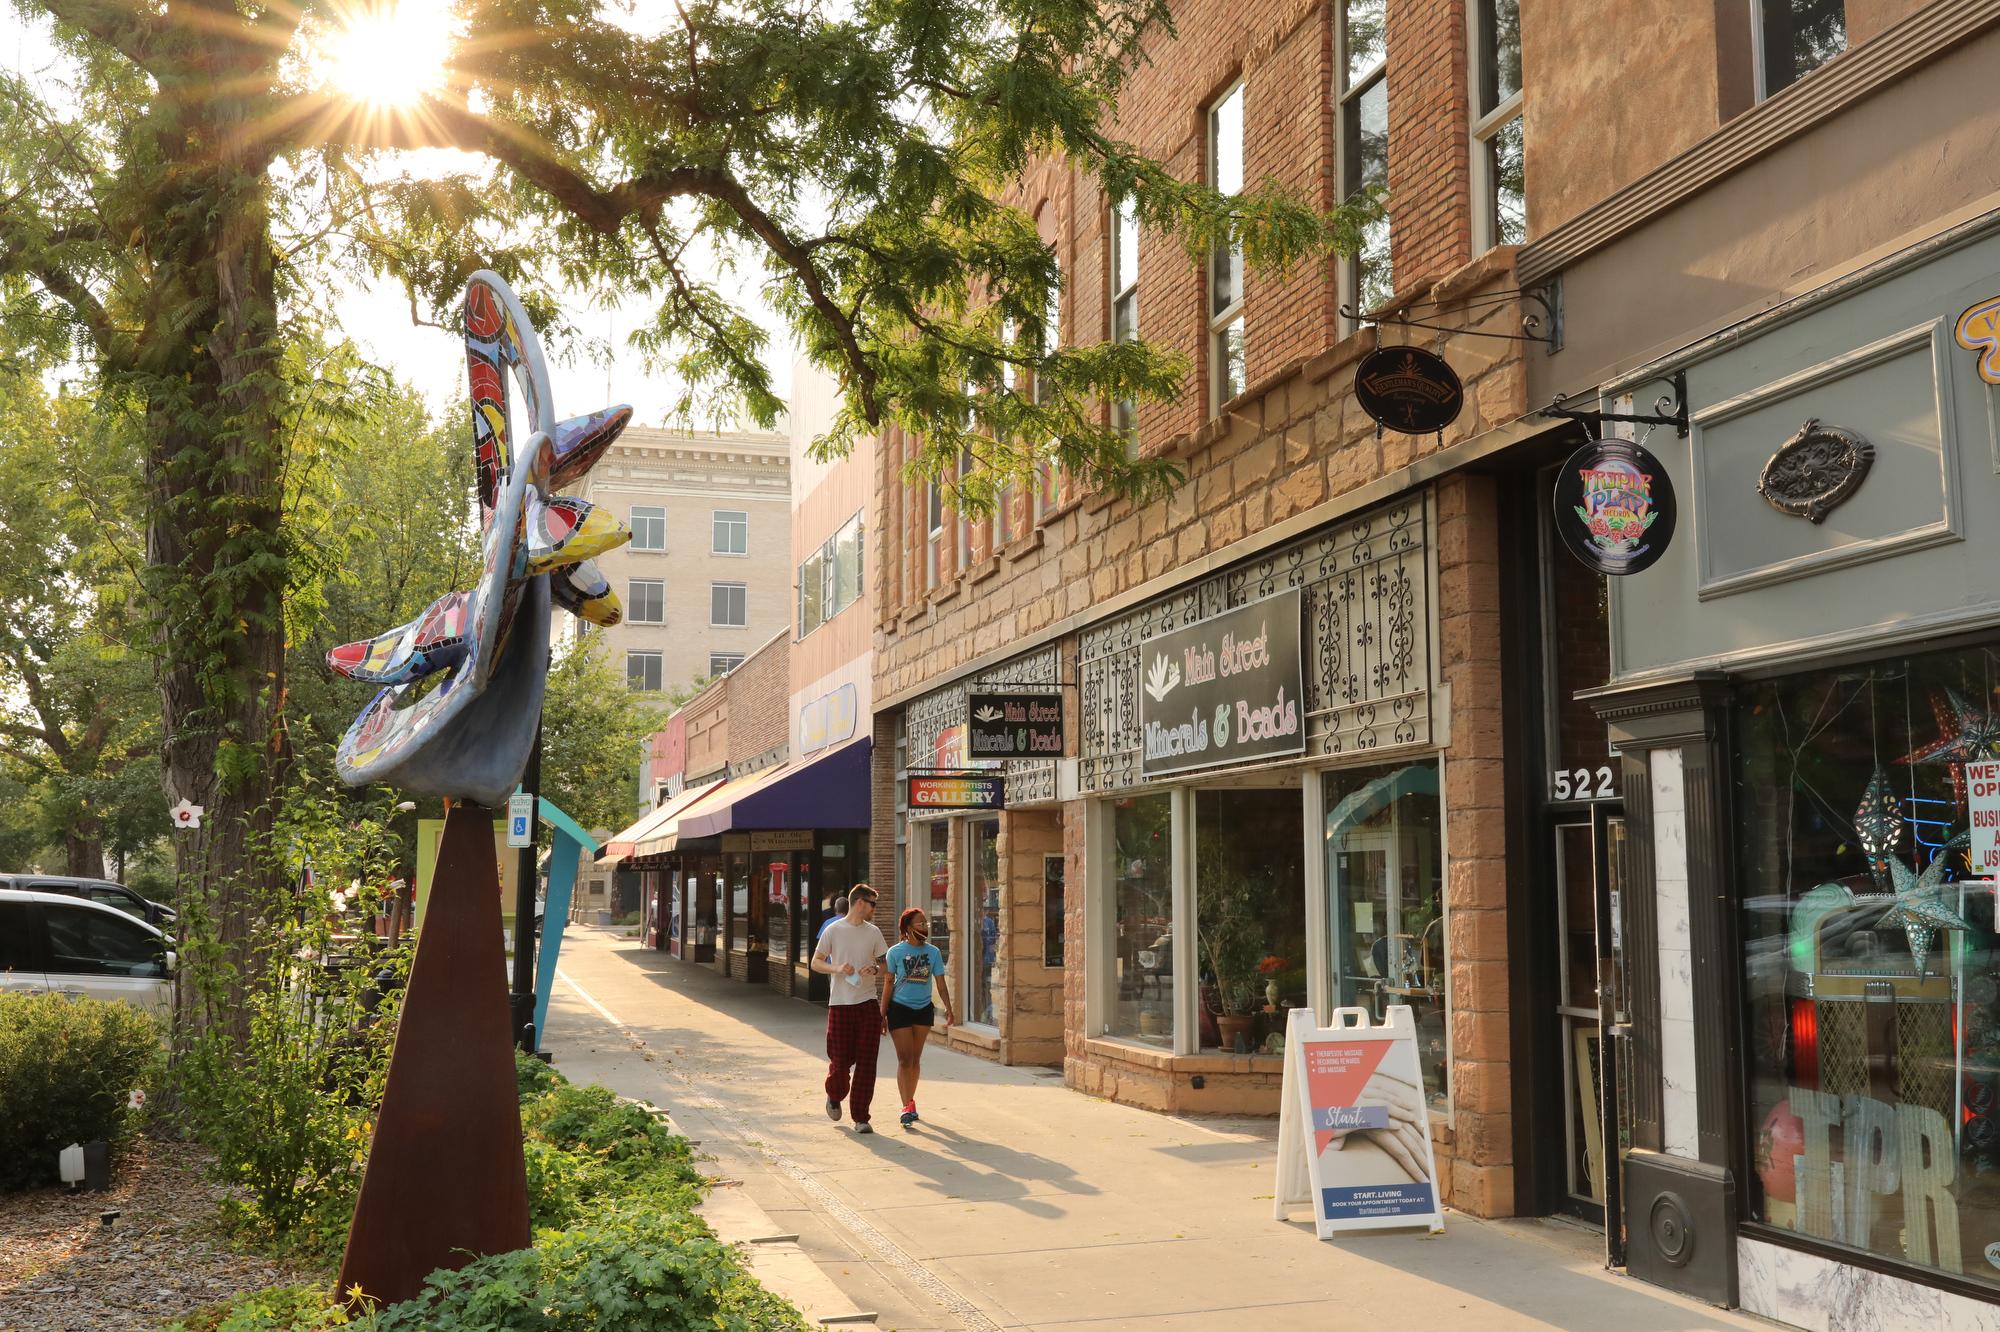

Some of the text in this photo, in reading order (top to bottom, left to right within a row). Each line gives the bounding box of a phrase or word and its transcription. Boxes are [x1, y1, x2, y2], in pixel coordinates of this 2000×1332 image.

[1184, 619, 1270, 687] Main Street
[1004, 700, 1061, 722] Main Street
[1145, 685, 1298, 761] Minerals & Beads
[972, 726, 1015, 752] Minerals
[1017, 728, 1027, 752] &
[1030, 726, 1062, 752] Beads
[1554, 766, 1614, 800] 522
[1973, 782, 2000, 797] OP
[916, 791, 995, 803] GALLERY
[511, 807, 529, 815] PARKING
[1973, 809, 2000, 828] BUSI
[1984, 849, 2000, 867] US
[1326, 1106, 1366, 1127] Start.
